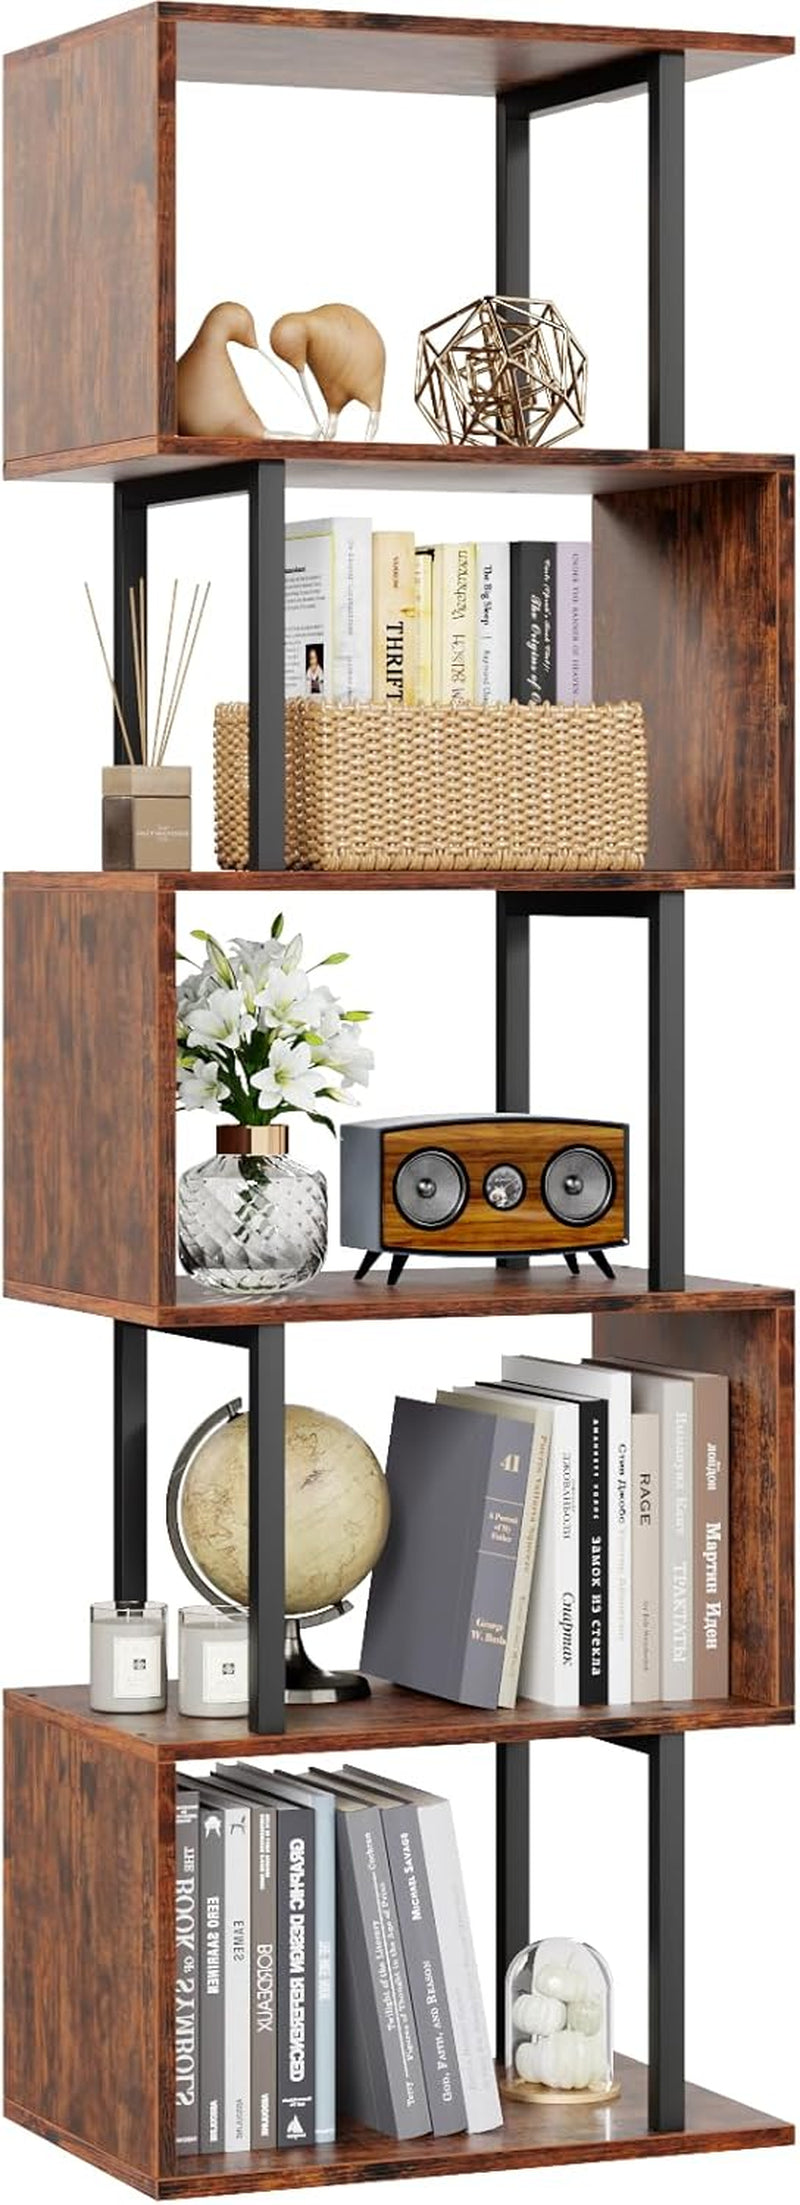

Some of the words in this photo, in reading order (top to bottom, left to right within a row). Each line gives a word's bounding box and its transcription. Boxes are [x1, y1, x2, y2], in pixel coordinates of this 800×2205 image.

[480, 583, 492, 600] Big
[484, 565, 492, 580] The
[481, 601, 493, 626] Sleep
[530, 595, 542, 619] The
[386, 621, 403, 701] THRIFT
[526, 623, 542, 671] Origins
[526, 673, 542, 690] of
[500, 1453, 520, 1473] 41
[618, 1443, 627, 1475] Стив
[617, 1479, 627, 1523] Джобс
[640, 1473, 651, 1526] RAGE
[703, 1522, 721, 1593] Мартин
[559, 1592, 575, 1666] Спартак
[672, 1560, 687, 1662] ТРАКТАТЫ
[704, 1601, 721, 1649] Иден
[400, 1832, 415, 1873] SAVAGE
[406, 1875, 422, 1920] MICHAEL
[380, 1979, 389, 1988] of
[422, 1961, 437, 2004] REASON
[383, 1990, 396, 2030] Twilight
[430, 2007, 441, 2029] AND
